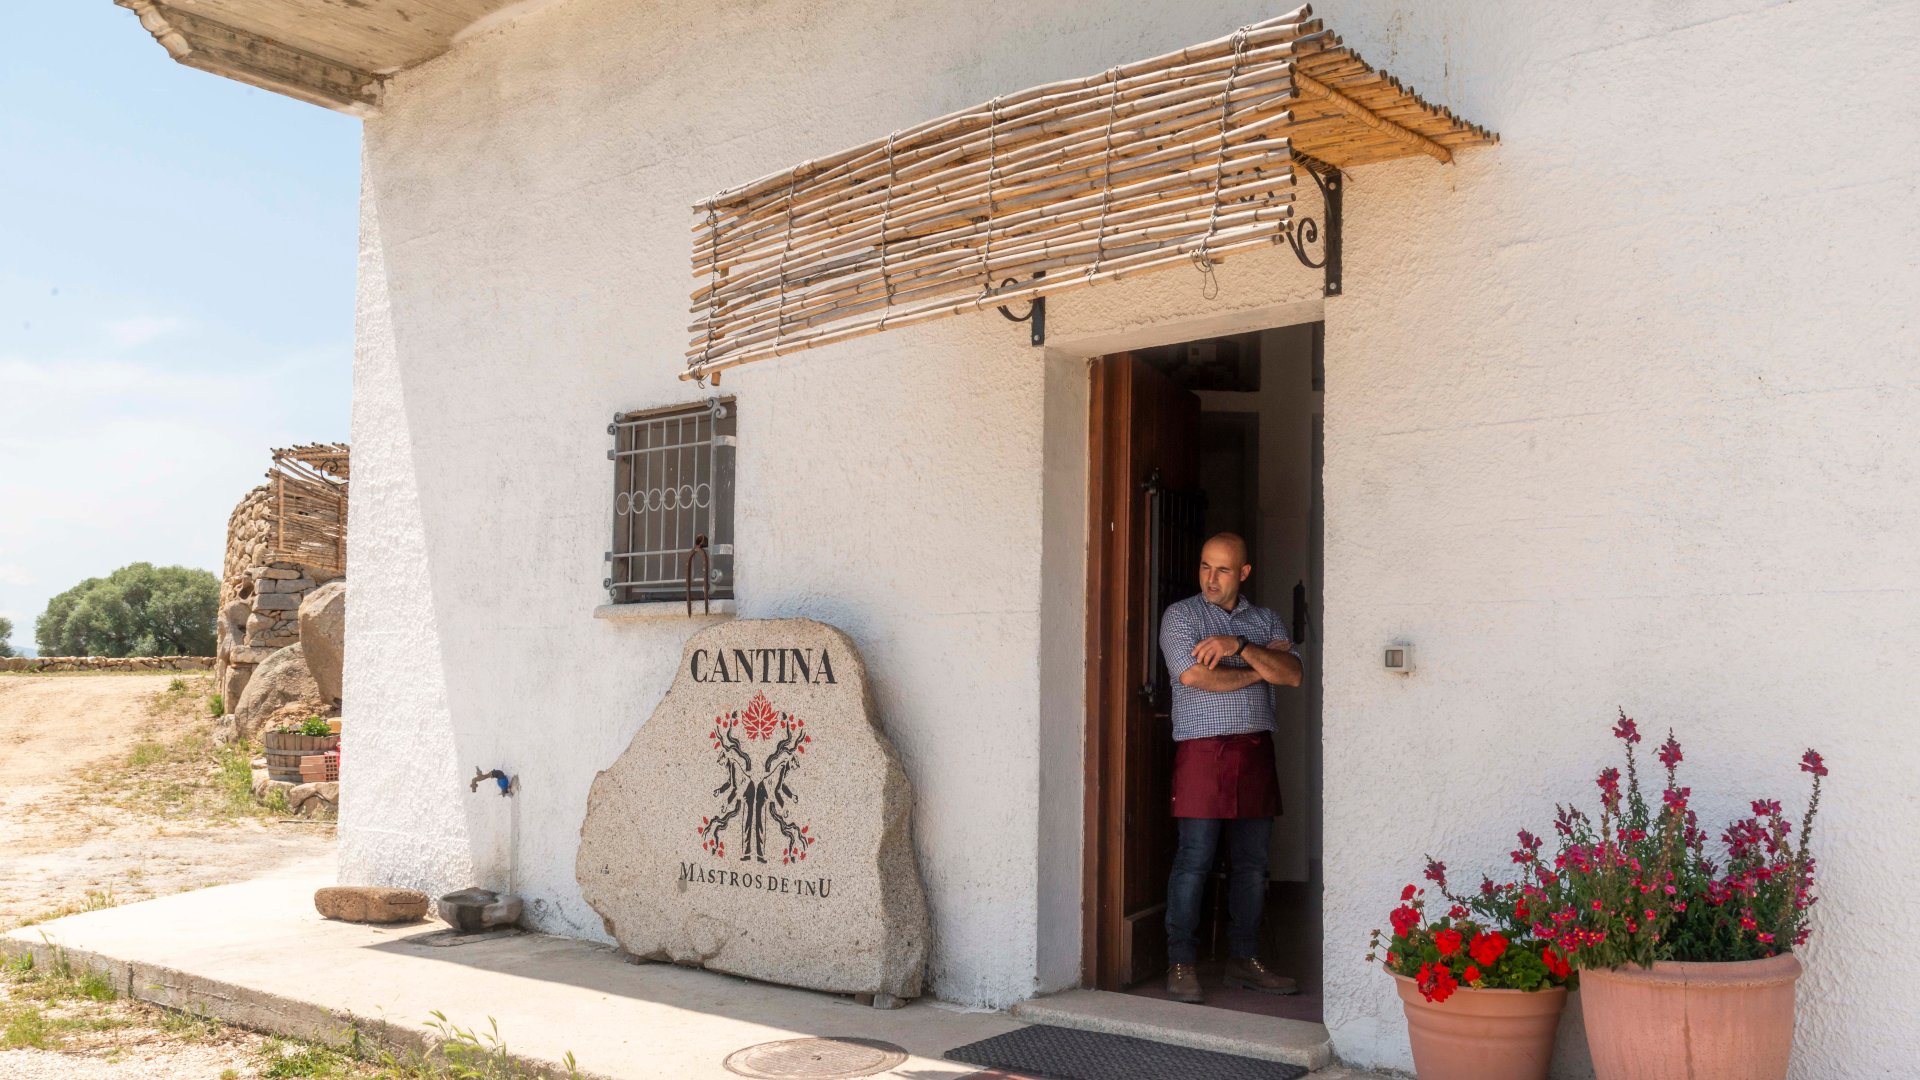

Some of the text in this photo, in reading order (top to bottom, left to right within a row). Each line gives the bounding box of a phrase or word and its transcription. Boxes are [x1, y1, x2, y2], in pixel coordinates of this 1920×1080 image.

[690, 648, 838, 684] CANTINA
[678, 862, 762, 889] MASTROS
[767, 875, 789, 893] DE
